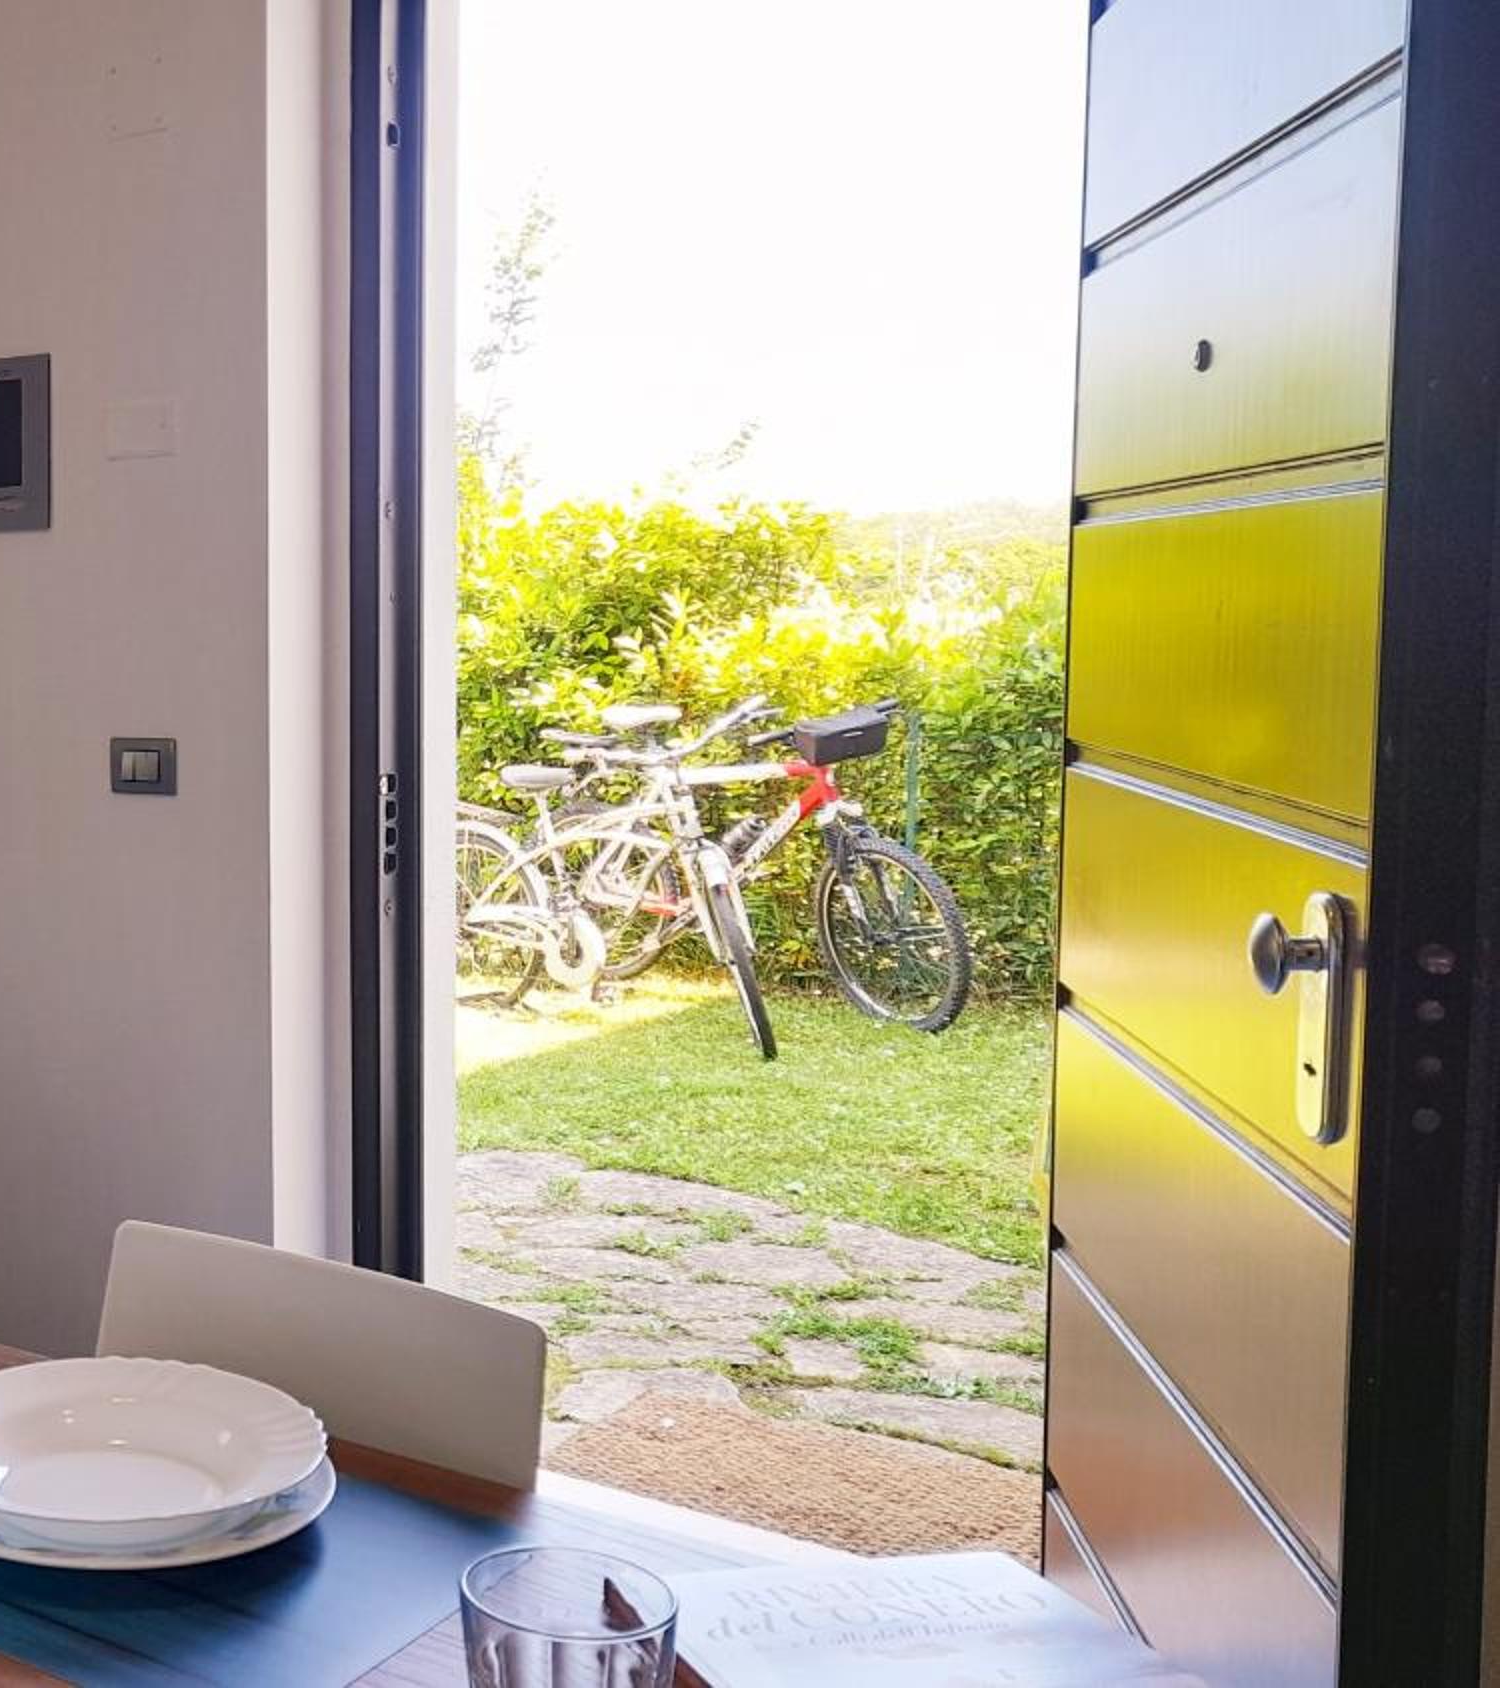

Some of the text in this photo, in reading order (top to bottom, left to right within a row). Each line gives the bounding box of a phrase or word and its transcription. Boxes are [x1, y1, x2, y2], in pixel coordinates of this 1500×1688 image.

[726, 1573, 974, 1611] RIVIERA
[706, 1592, 1048, 1640] del CONERO
